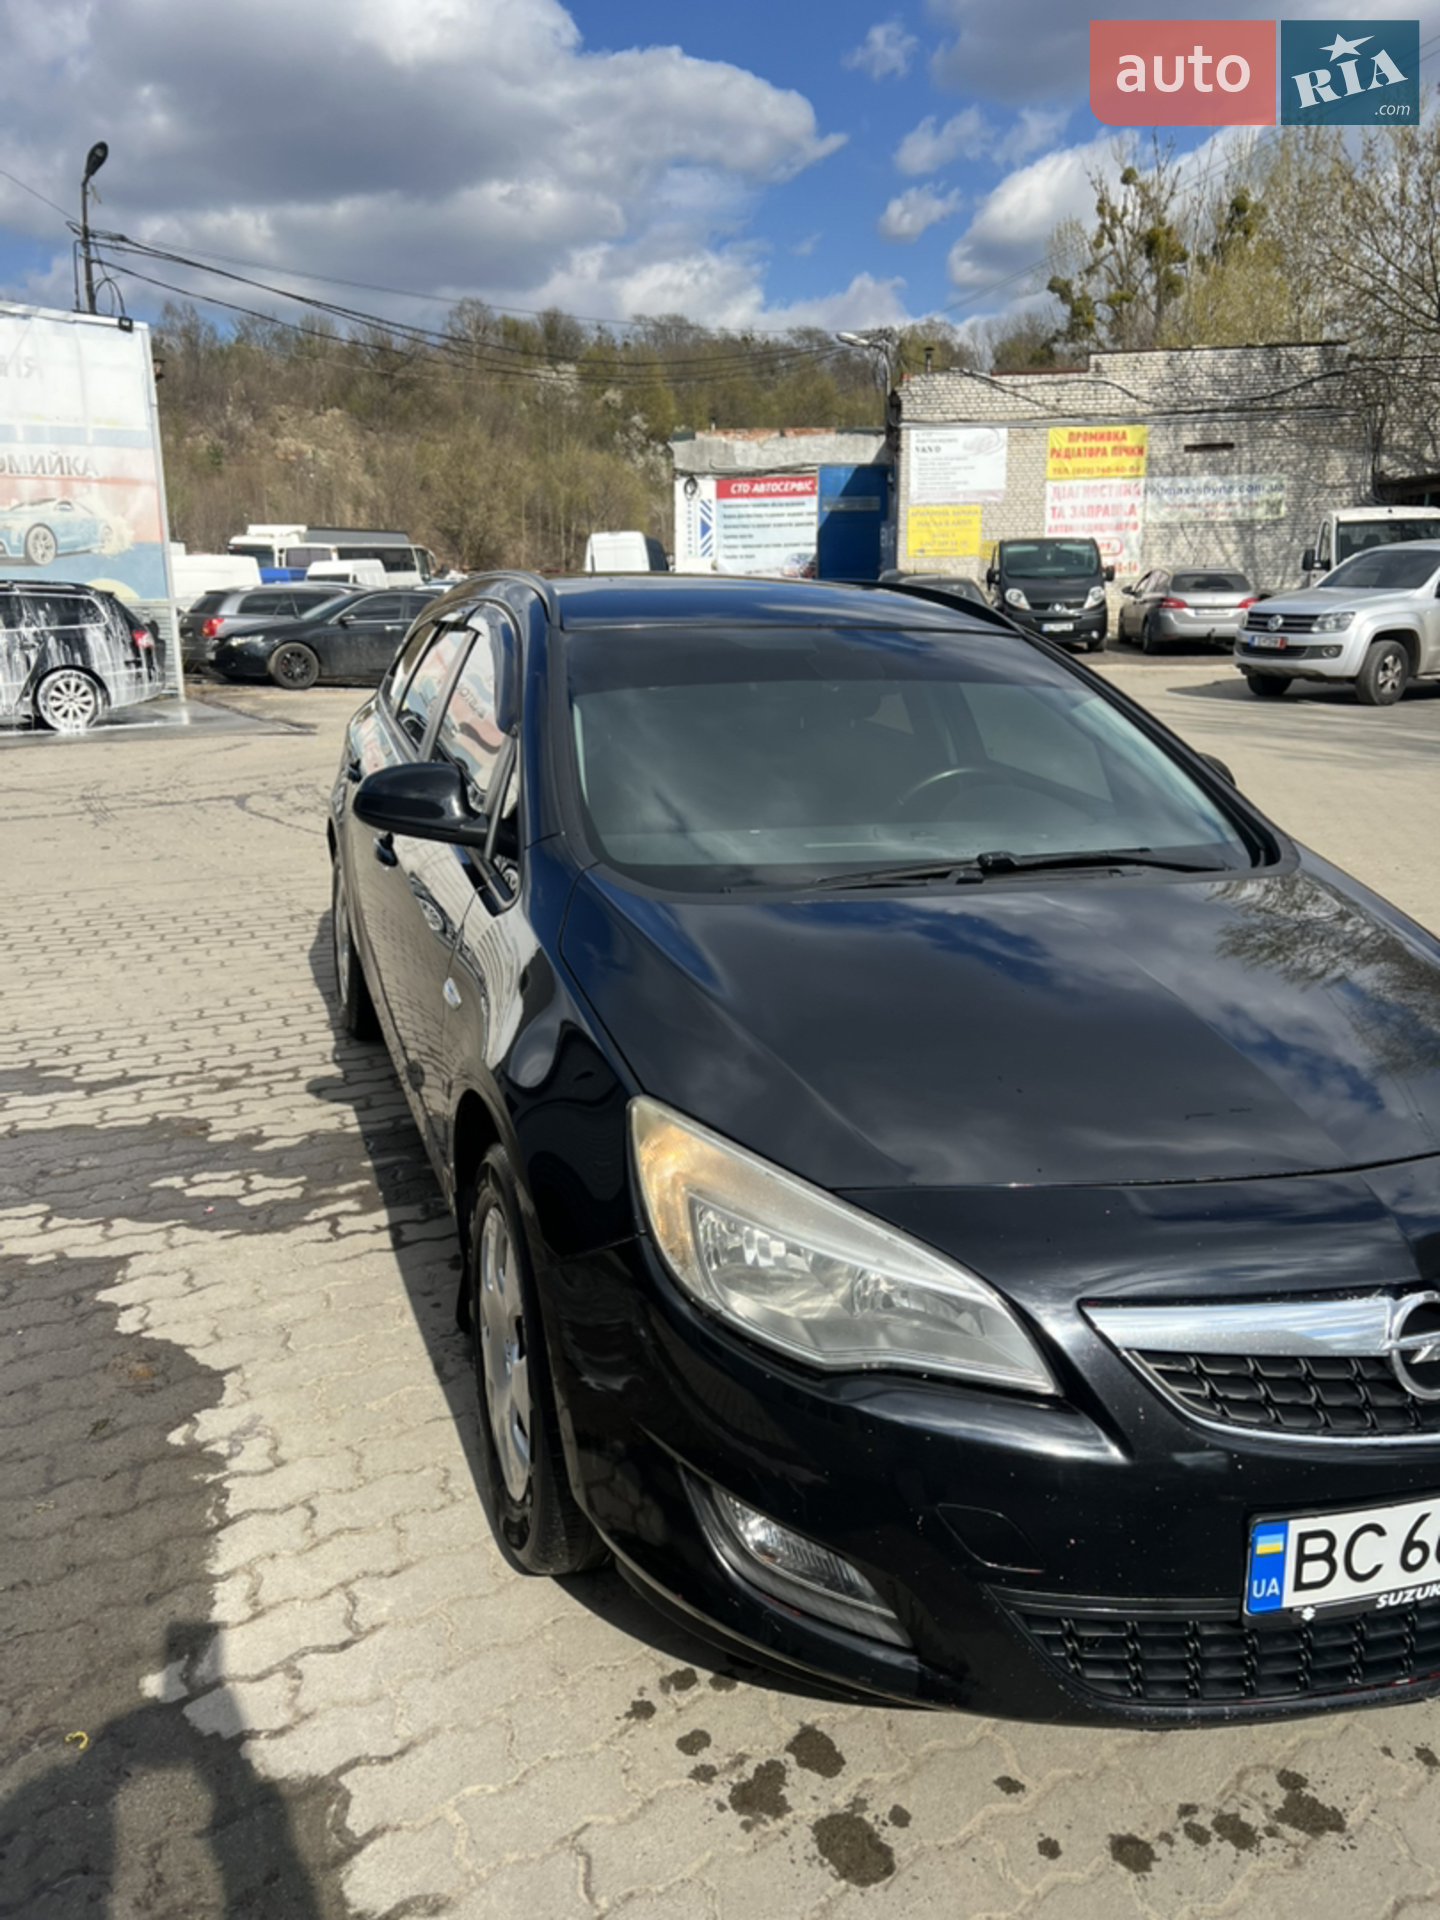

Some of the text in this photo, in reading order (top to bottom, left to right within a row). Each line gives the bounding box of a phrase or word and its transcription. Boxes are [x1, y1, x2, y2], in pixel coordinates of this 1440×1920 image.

[1068, 430, 1127, 443] ПРОМИВКА
[1293, 1523, 1387, 1592] BC
[1252, 1578, 1280, 1598] UA
